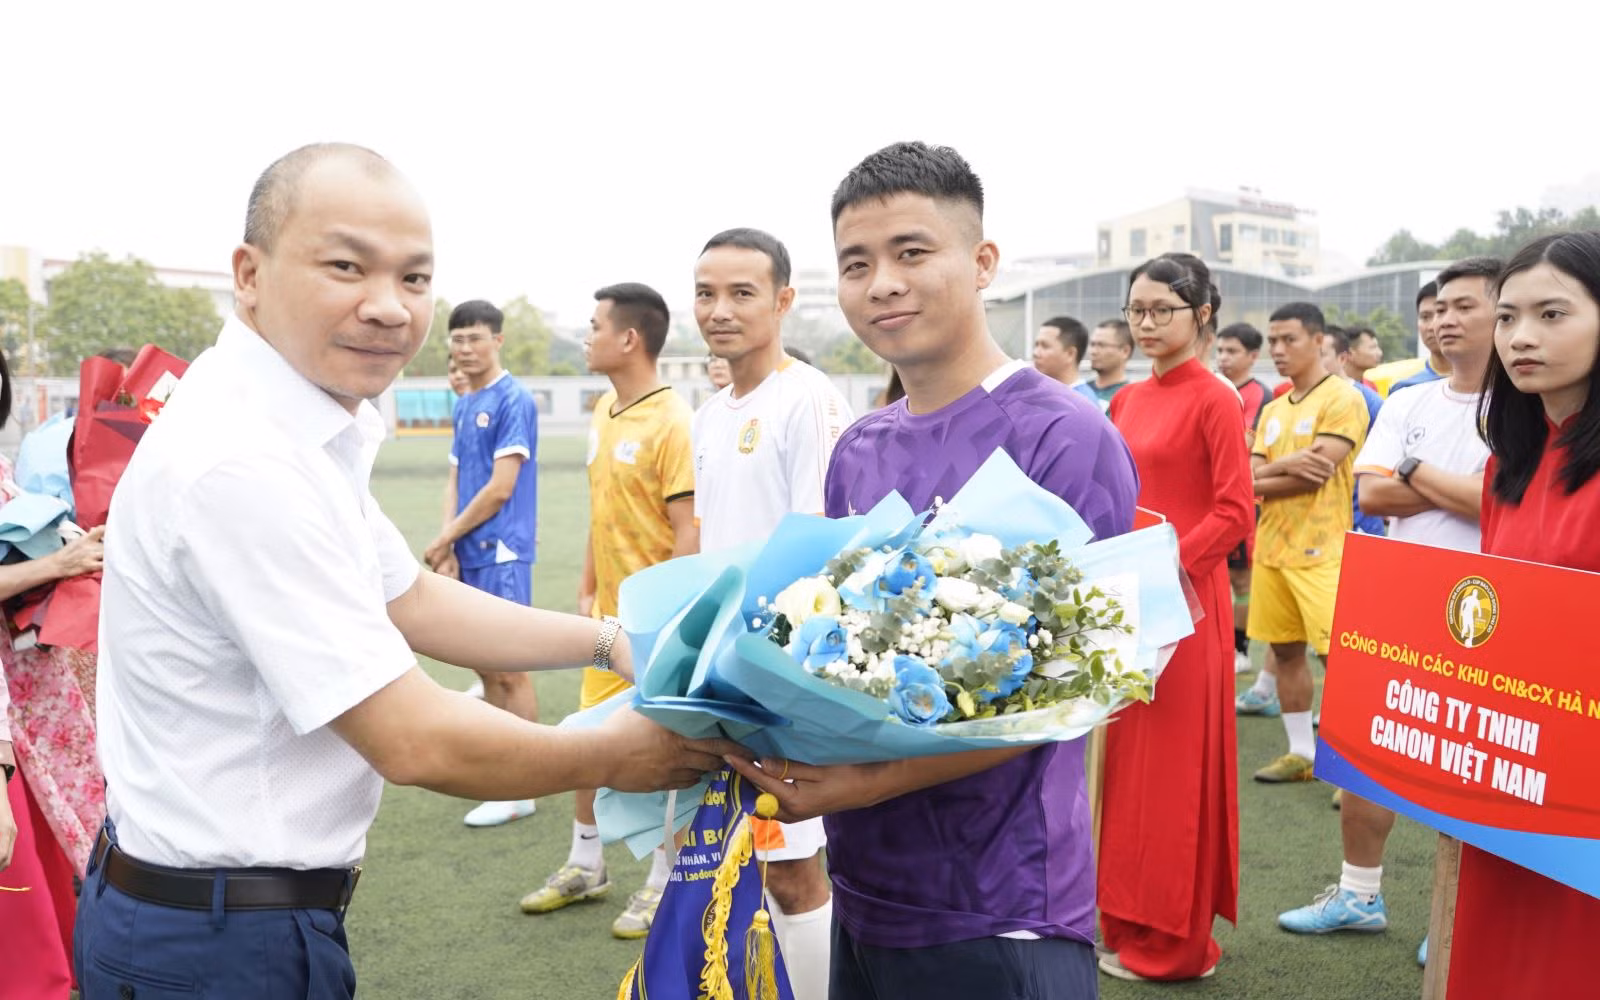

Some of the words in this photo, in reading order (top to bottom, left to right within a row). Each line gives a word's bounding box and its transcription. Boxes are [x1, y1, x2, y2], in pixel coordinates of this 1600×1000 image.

[1340, 631, 1378, 656] CÔNG
[1381, 643, 1419, 668] ĐOÀN
[1422, 653, 1455, 677] CÁC
[1457, 664, 1489, 687] KHU
[1492, 674, 1554, 706] CN&CX
[1557, 690, 1583, 715] HÀ
[1385, 679, 1440, 724] CÔNG
[1445, 697, 1472, 733] TY
[1477, 706, 1540, 757] TNHH
[1370, 715, 1436, 765] CANON
[1440, 738, 1488, 784] VIỆT
[1491, 756, 1547, 806] NAM
